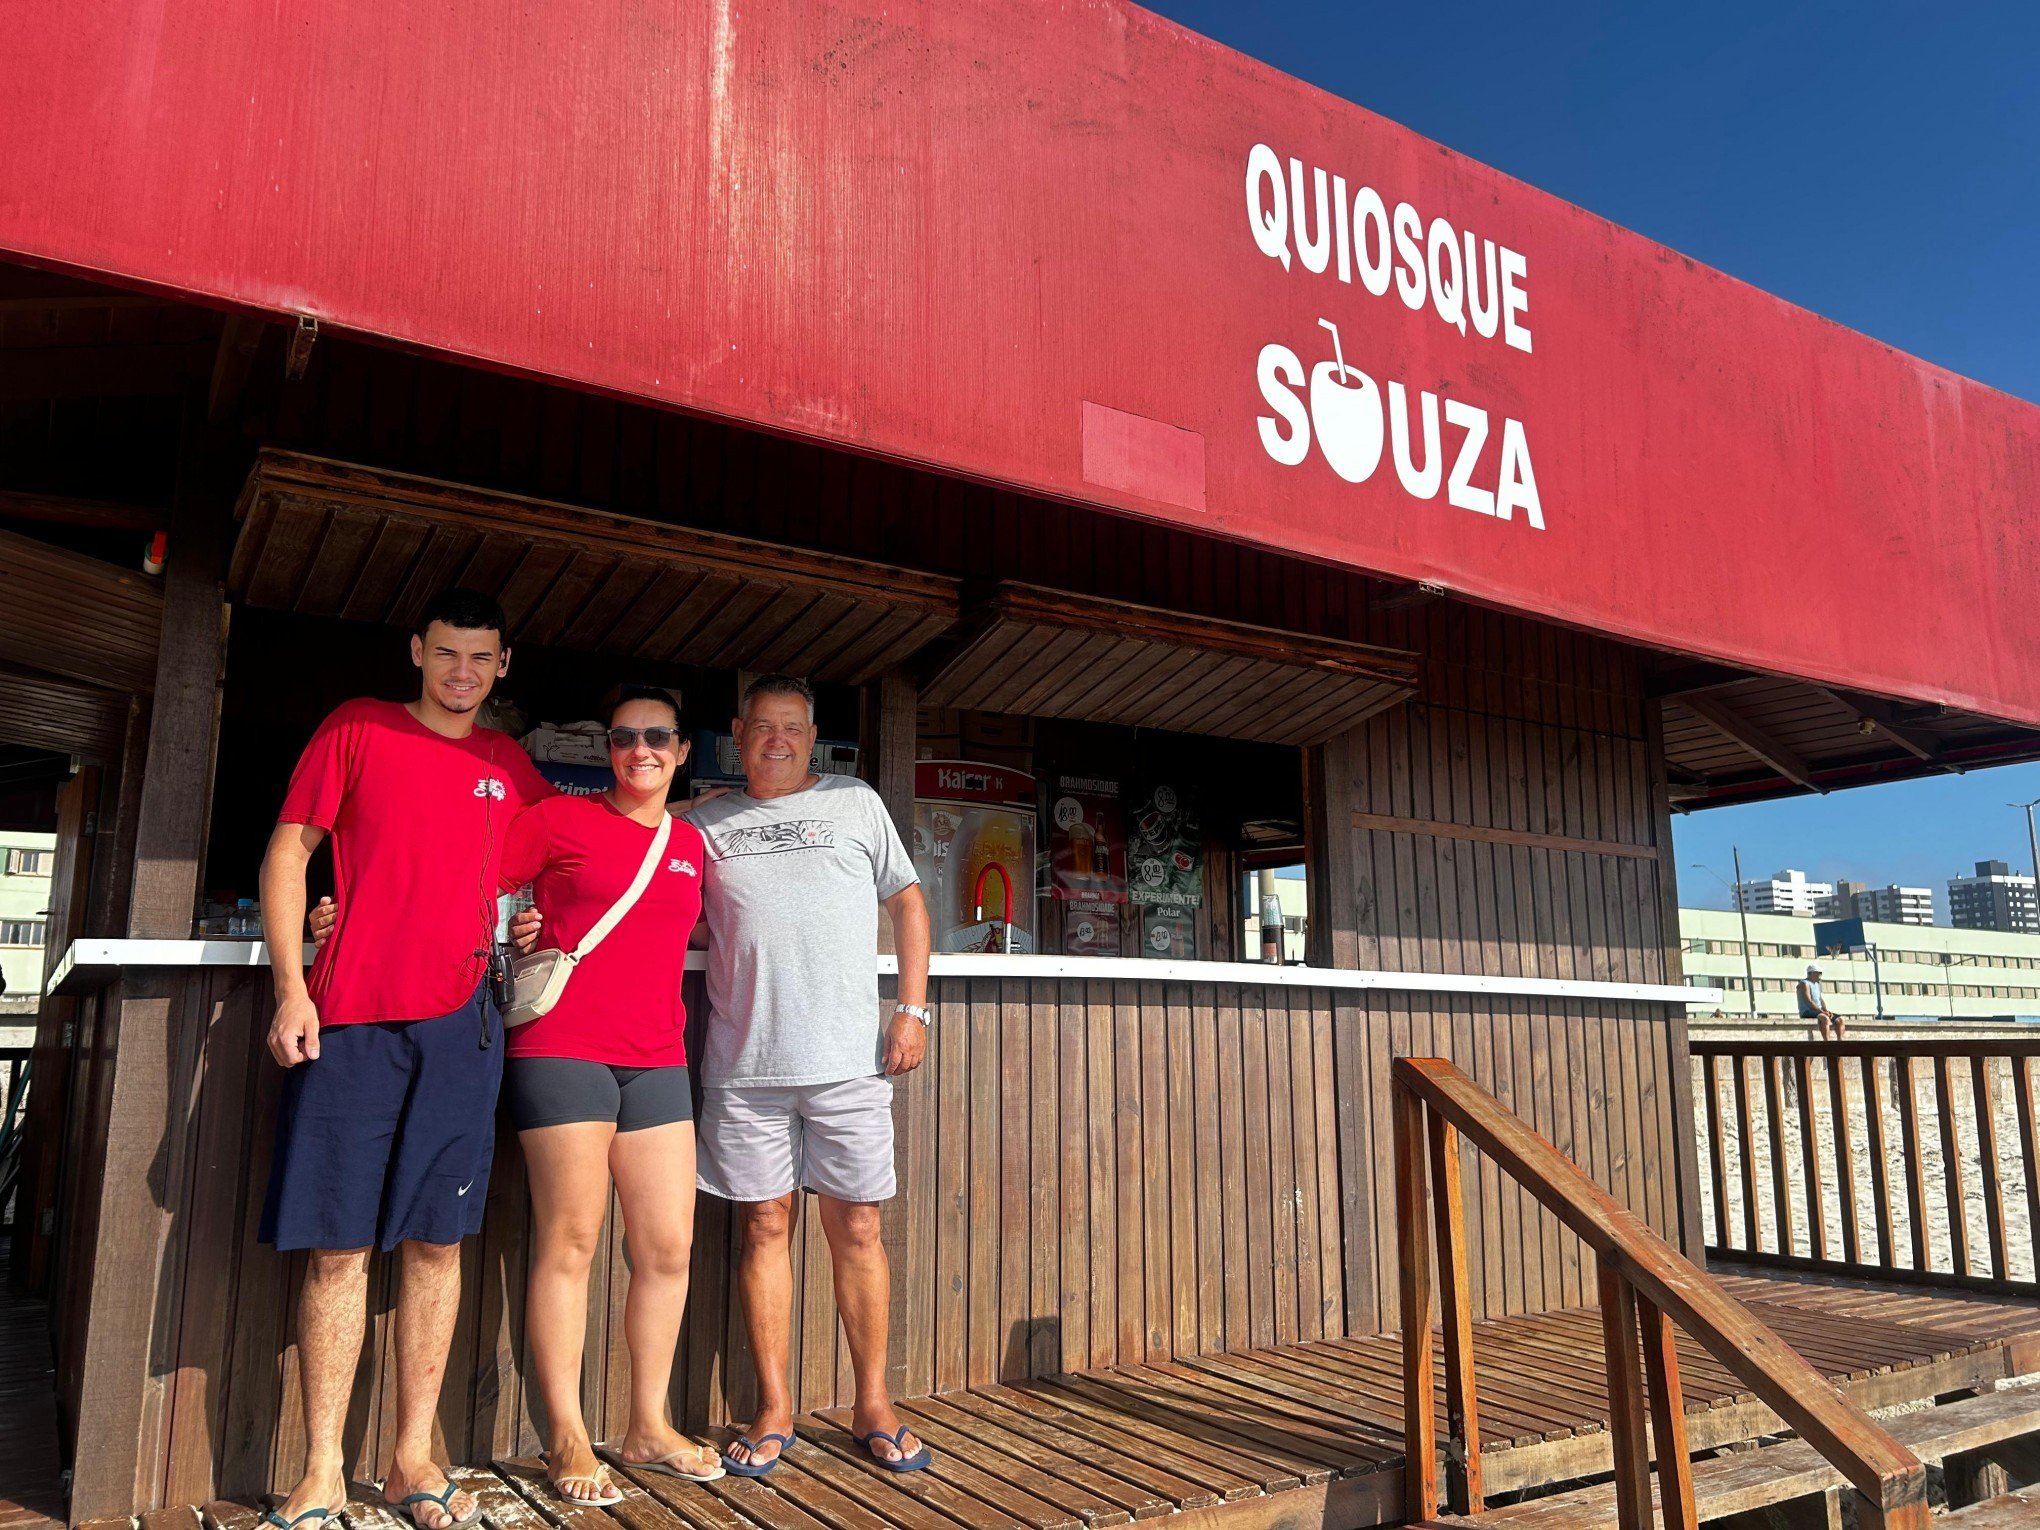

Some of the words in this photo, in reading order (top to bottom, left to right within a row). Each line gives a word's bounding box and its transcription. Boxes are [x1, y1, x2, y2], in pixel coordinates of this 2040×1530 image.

[1245, 143, 1533, 354] QUIOSQUE
[1256, 318, 1546, 530] SOUZA
[1059, 775, 1119, 794] BRAHMOSIDADE
[1069, 900, 1115, 914] BRAHMOSIDADE
[1132, 890, 1202, 907] EXPERIMENTE!
[1157, 907, 1182, 918] Polar
